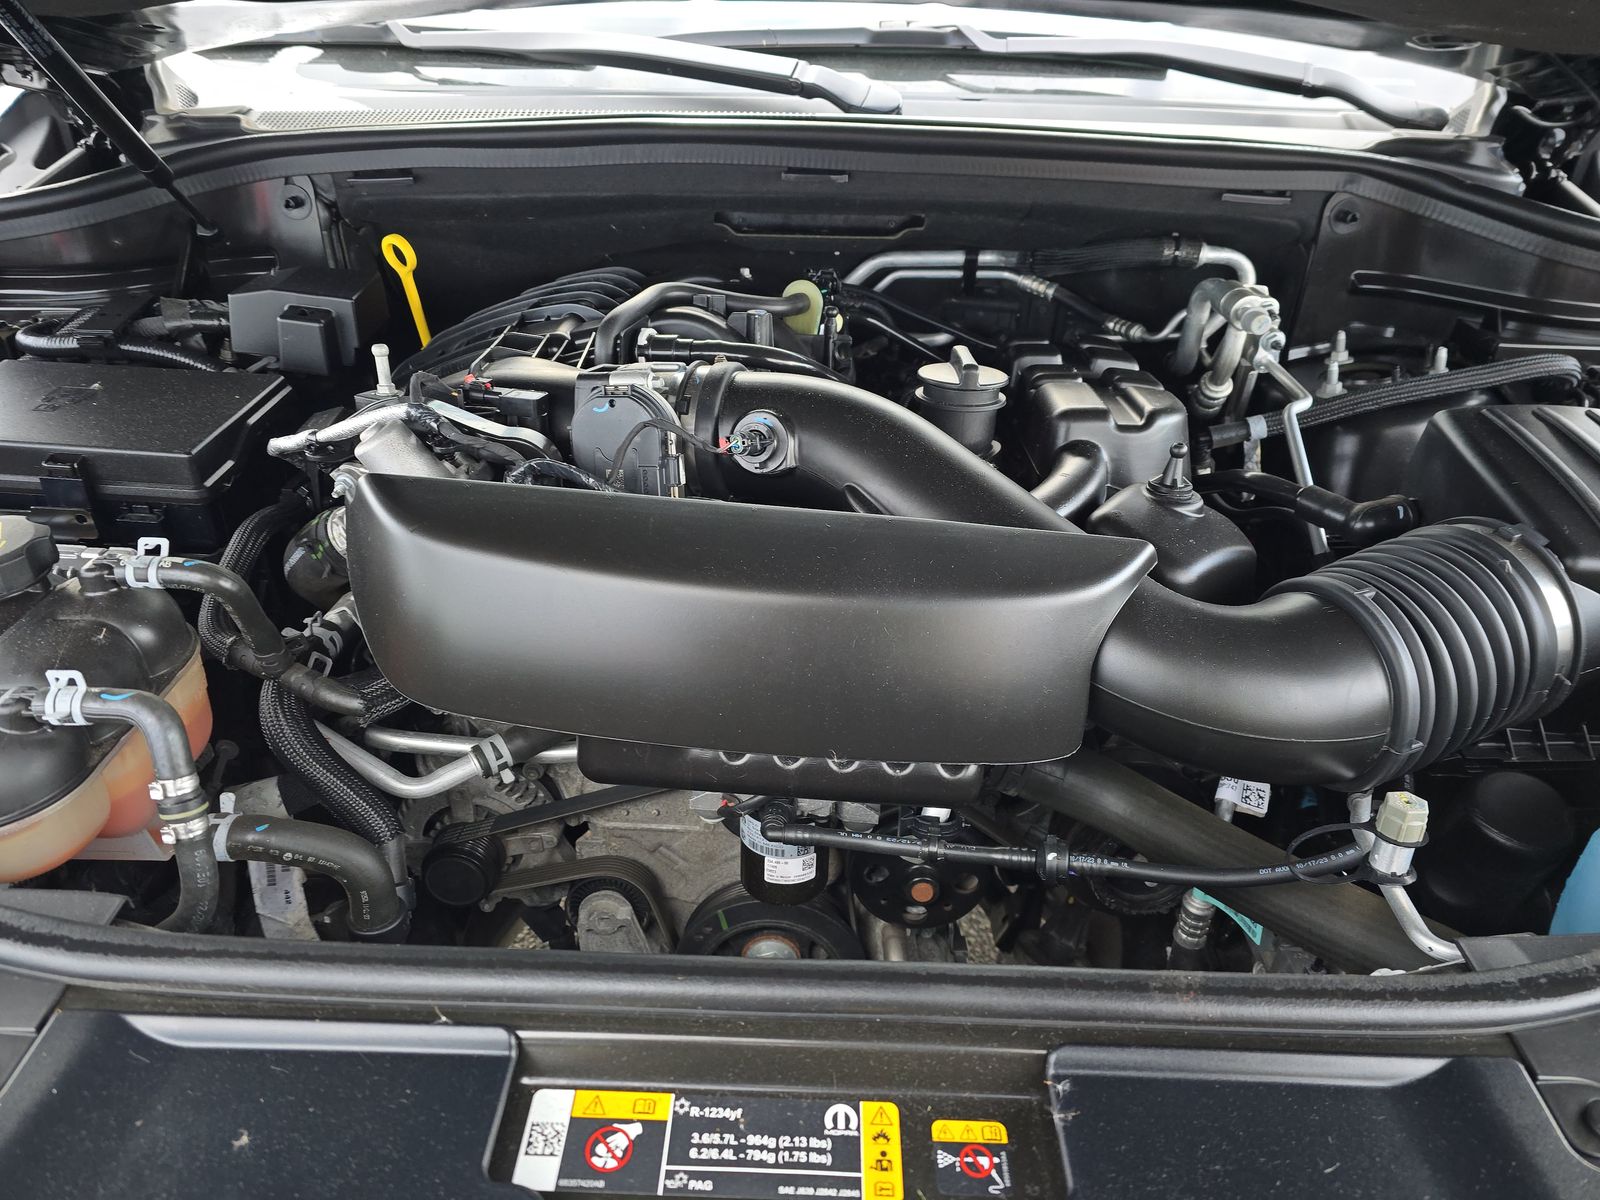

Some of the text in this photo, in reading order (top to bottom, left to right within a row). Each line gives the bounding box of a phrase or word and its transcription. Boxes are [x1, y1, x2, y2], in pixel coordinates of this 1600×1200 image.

[689, 1106, 743, 1121] R-1234yf
[691, 1132, 738, 1146] 3.6/5.7L
[778, 1136, 808, 1149] (2.13
[809, 1137, 832, 1151] lbs)
[689, 1147, 738, 1161] 6.2/6.4L
[777, 1150, 808, 1164] (1.75
[809, 1152, 832, 1166] lbs)
[688, 1179, 714, 1191] PAG
